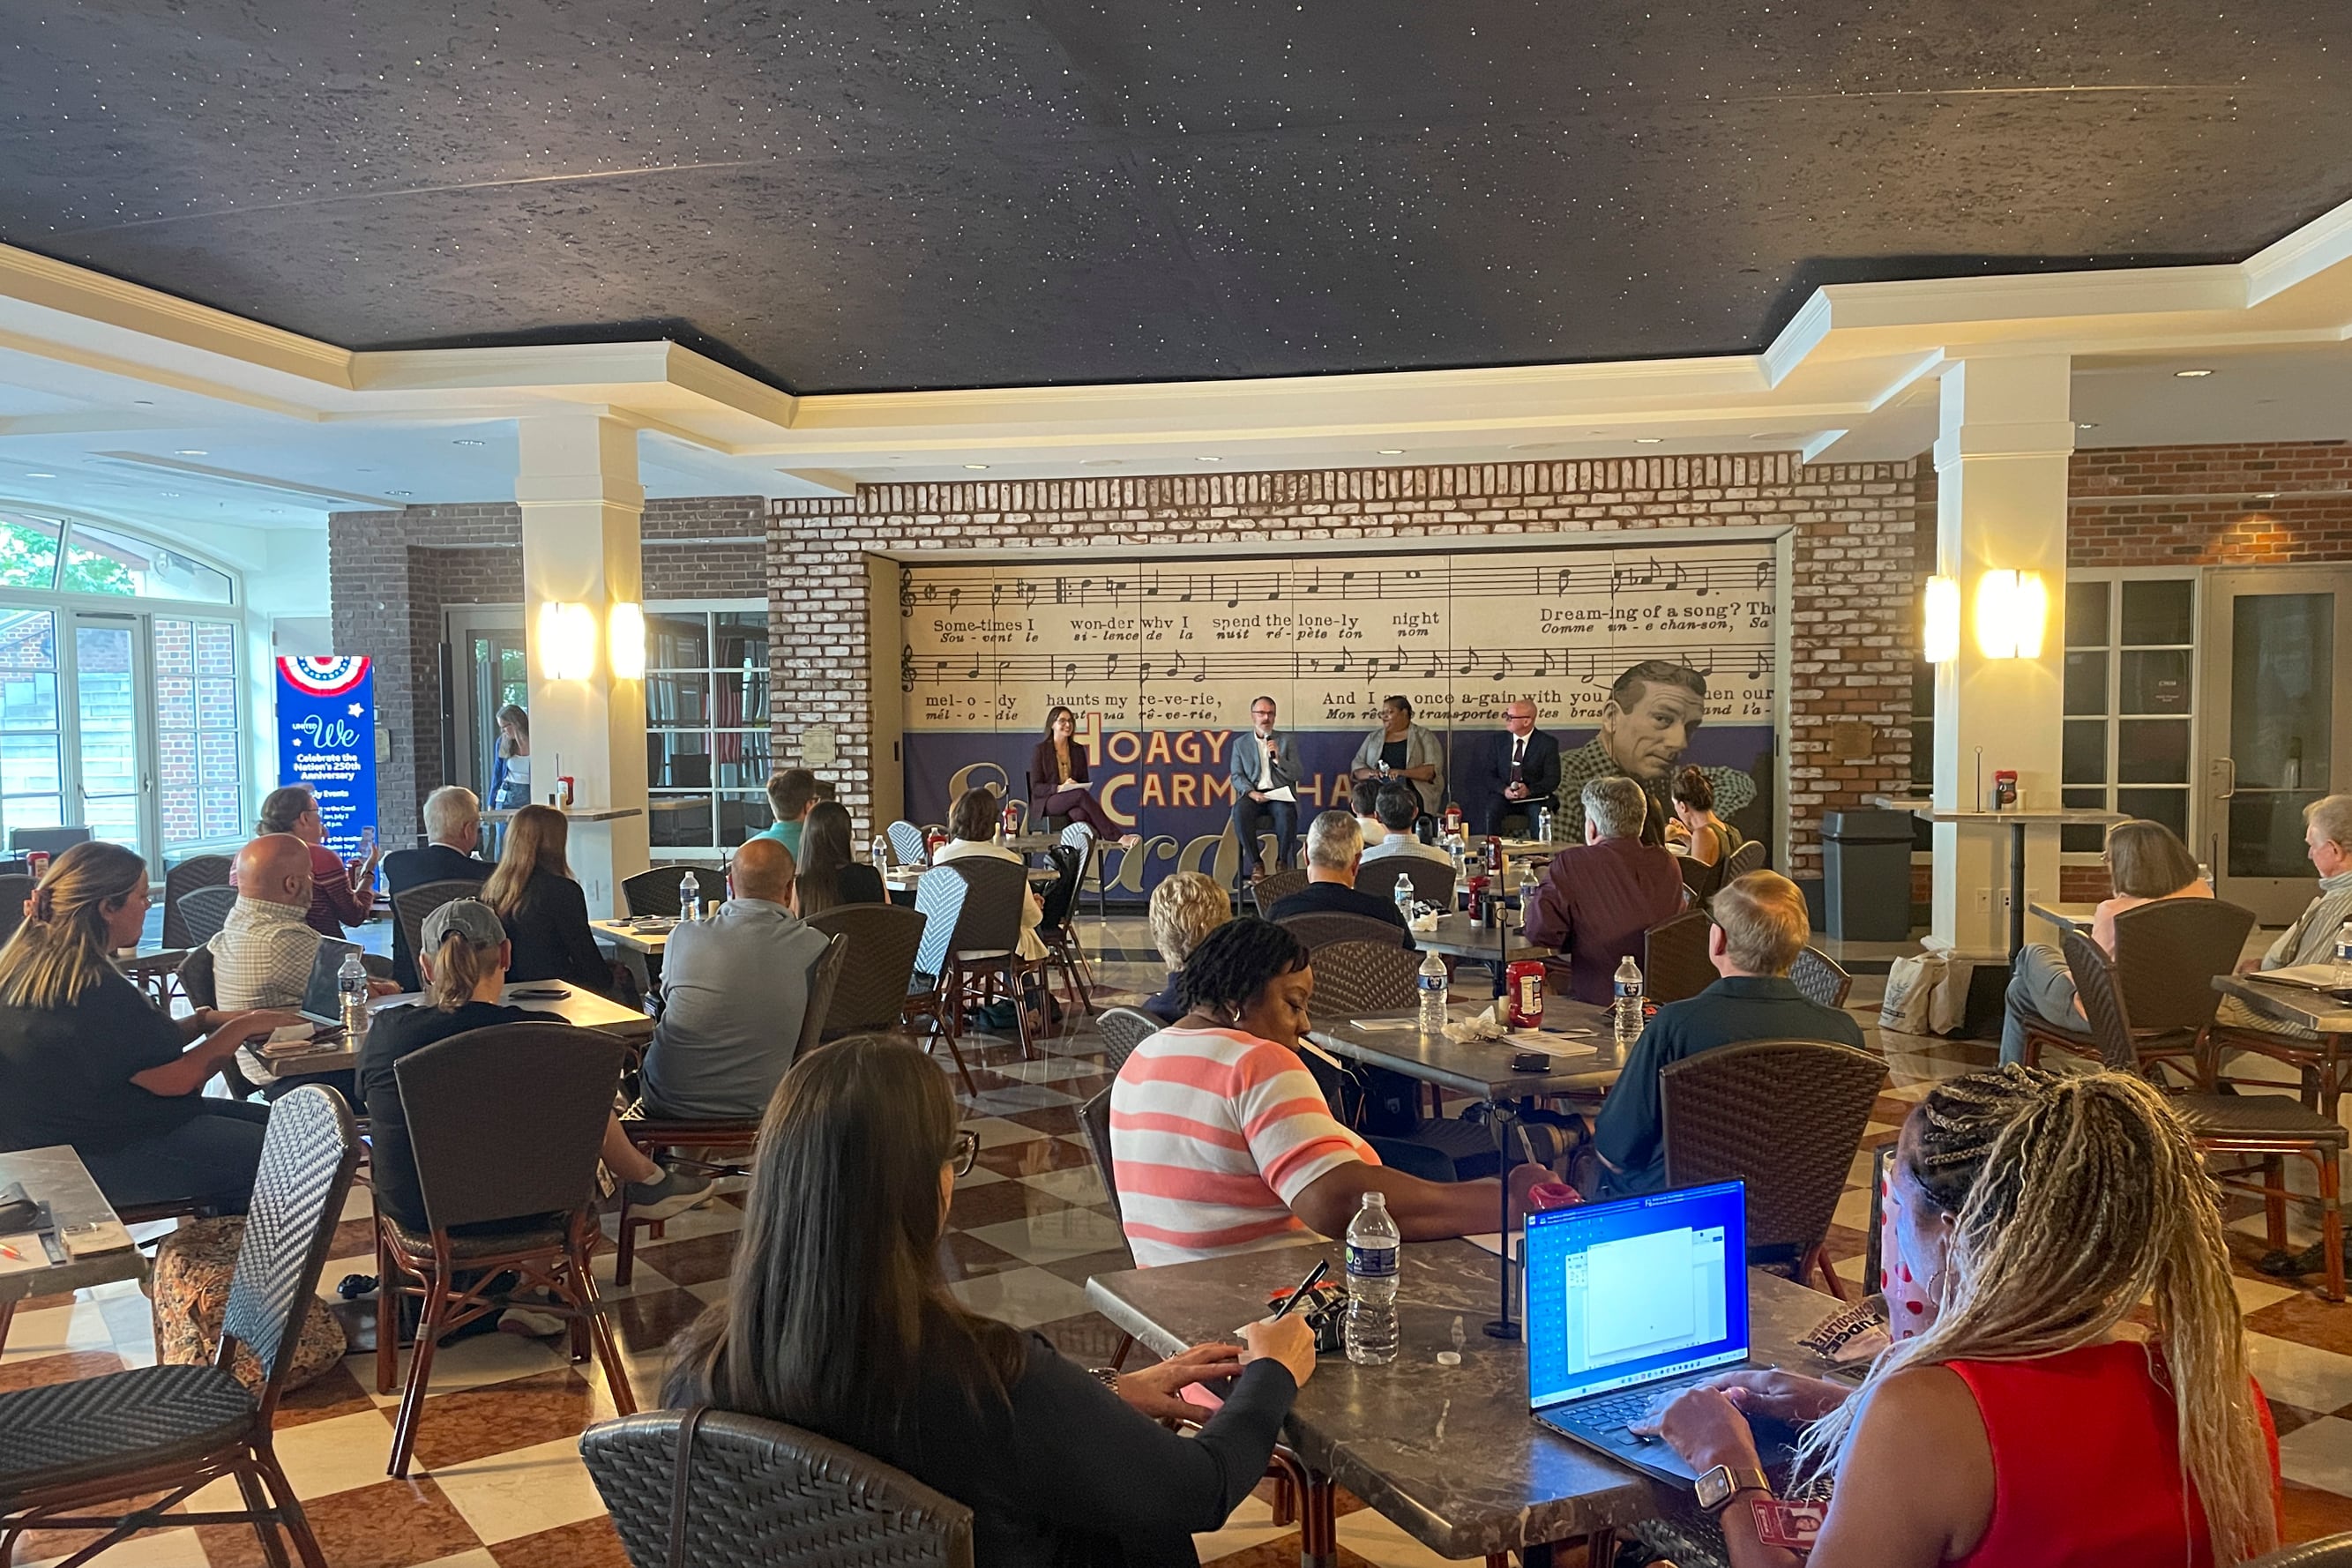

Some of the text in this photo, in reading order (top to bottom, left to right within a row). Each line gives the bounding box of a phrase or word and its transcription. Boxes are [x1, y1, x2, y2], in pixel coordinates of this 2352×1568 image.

[1540, 607, 1639, 622] Dream-ing
[1643, 605, 1662, 618] of
[1667, 607, 1678, 617] a
[1684, 601, 1742, 619] song?
[1027, 618, 1034, 631] I
[1070, 616, 1134, 630] won-der
[1182, 616, 1189, 629] I
[1213, 615, 1261, 631] spend
[1266, 614, 1292, 627] the
[1299, 614, 1359, 630] lone-ly
[1393, 612, 1439, 628] night
[1542, 623, 1594, 634] Comme
[1608, 623, 1628, 632] un
[1646, 623, 1654, 631] e
[1749, 616, 1770, 629] Sa
[940, 631, 965, 643] Sou
[1026, 631, 1039, 643] le
[1073, 631, 1087, 642] si
[1102, 630, 1139, 641] lence
[1146, 630, 1162, 641] de
[1179, 629, 1193, 640] la
[1216, 629, 1249, 640] nuit
[1339, 627, 1363, 639] ton
[1397, 628, 1429, 638] nom
[998, 694, 1017, 710] dy
[1046, 693, 1100, 706] haunts
[1105, 696, 1129, 709] my
[1323, 691, 1356, 705] And
[1368, 691, 1376, 705] I
[1414, 693, 1455, 705] once
[1522, 690, 1562, 703] with
[1570, 692, 1603, 706] you
[1743, 689, 1774, 700] our
[926, 708, 950, 721] mél
[995, 710, 1019, 721] die
[1326, 709, 1355, 720] Mon
[1538, 707, 1559, 719] tes
[1570, 707, 1603, 718] bras
[1703, 705, 1732, 715] and
[303, 713, 361, 749] We
[1075, 713, 1234, 767] HOAGY
[296, 752, 358, 763] Celebrate the
[293, 761, 362, 772] Nation's 250th
[301, 772, 355, 781] Anniversary
[1813, 1300, 1877, 1348] CHOCOLATE
[1826, 1312, 1885, 1355] FUDGE
